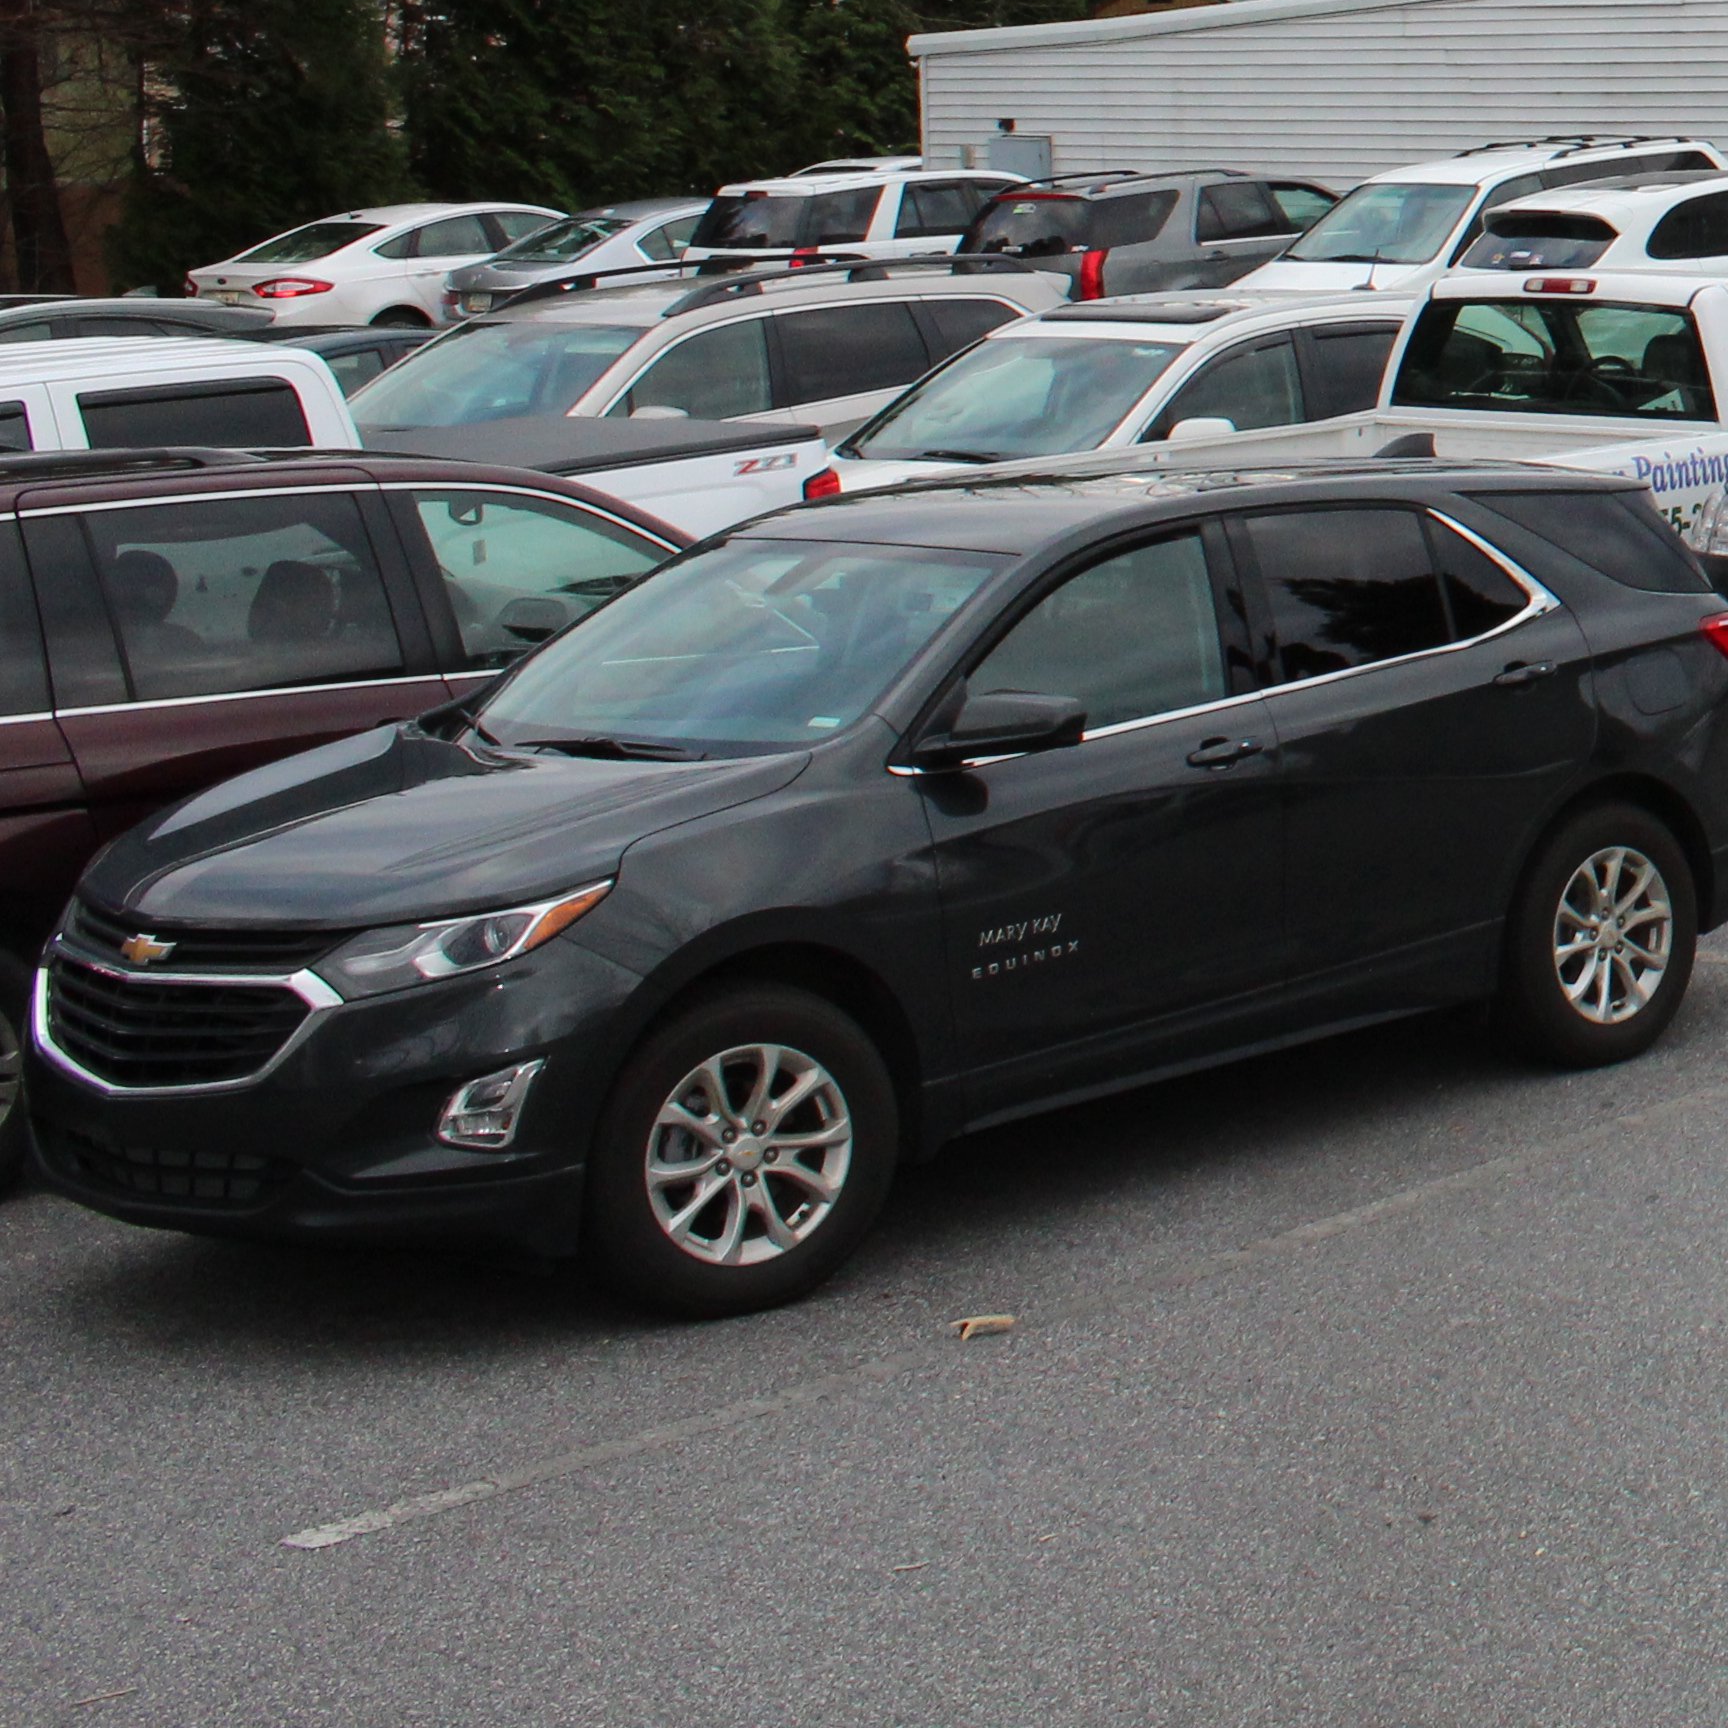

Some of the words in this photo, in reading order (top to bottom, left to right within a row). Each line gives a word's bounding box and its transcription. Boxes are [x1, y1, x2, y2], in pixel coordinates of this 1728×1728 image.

[979, 921, 1027, 946] MARY
[1032, 913, 1062, 934] KAY
[971, 939, 1079, 979] EQUINOX
